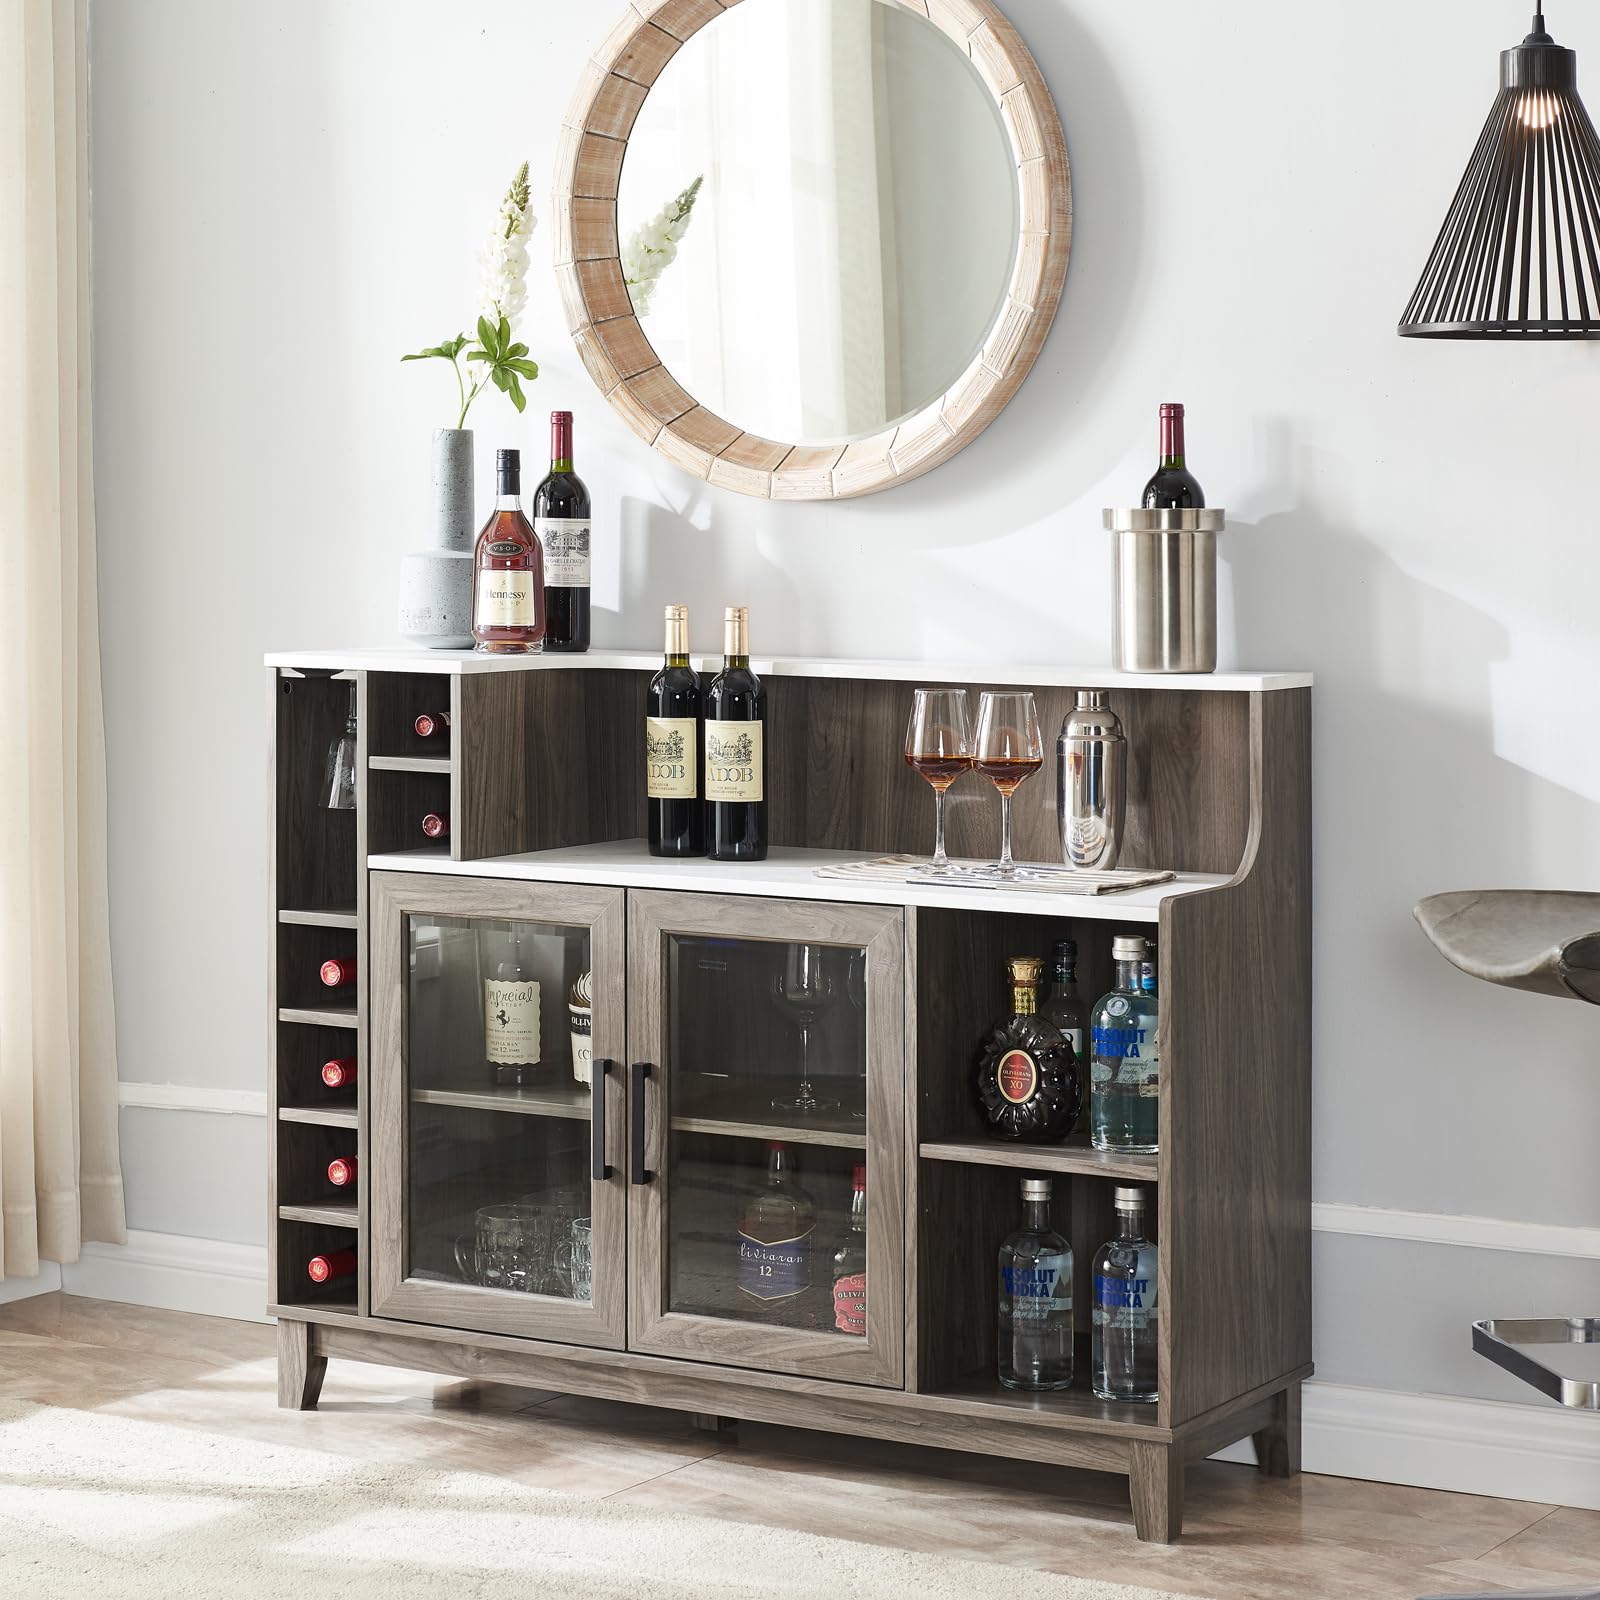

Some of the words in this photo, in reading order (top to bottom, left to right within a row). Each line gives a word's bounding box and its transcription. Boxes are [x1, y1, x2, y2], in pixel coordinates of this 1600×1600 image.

[486, 589, 527, 601] Hennessy
[708, 767, 754, 782] ADOB
[1010, 1080, 1023, 1089] XO
[759, 1265, 772, 1277] 12
[1094, 1274, 1149, 1294] SOLUT
